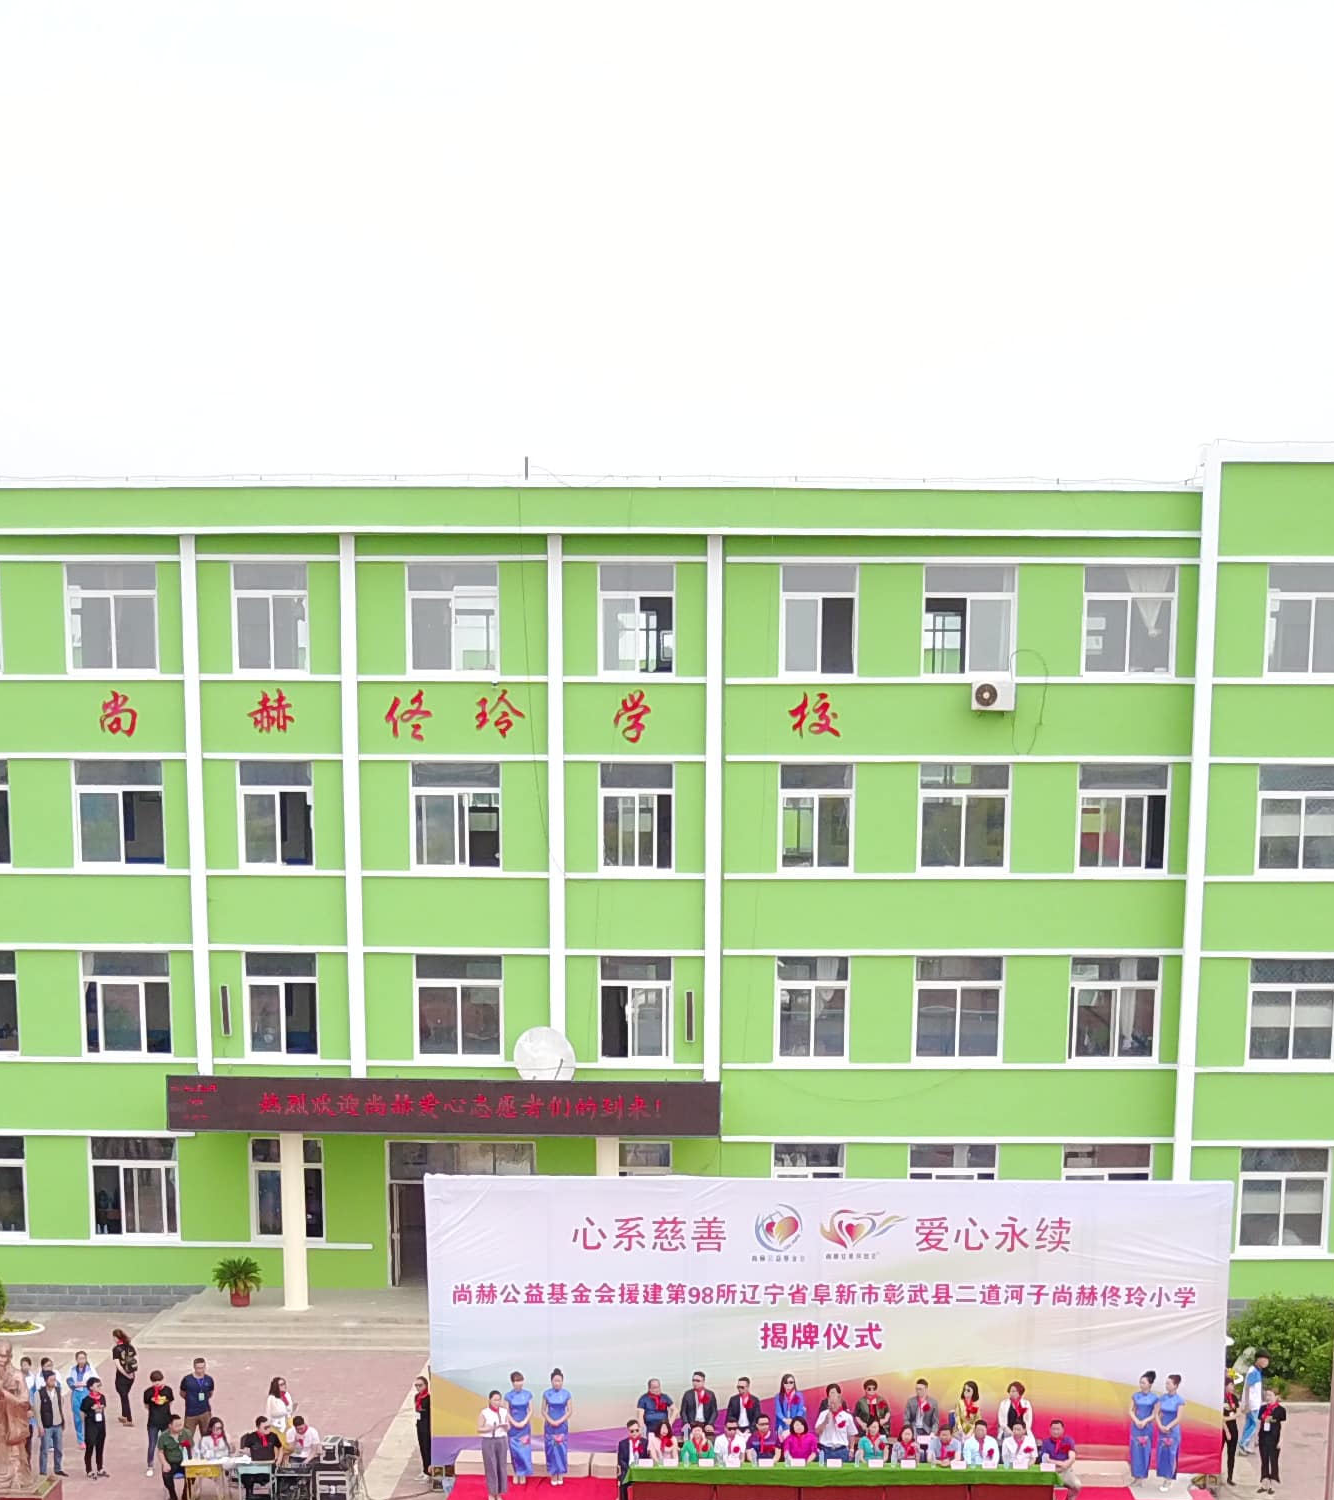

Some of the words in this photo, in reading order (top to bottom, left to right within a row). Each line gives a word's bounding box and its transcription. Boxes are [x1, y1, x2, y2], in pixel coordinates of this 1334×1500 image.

[99, 689, 842, 744] 尚赫佟玲学校
[571, 1216, 727, 1253] 心系慈善
[914, 1216, 1073, 1254] 爱心永续
[452, 1282, 1197, 1308] 尚赫公益基金会援建第98所辽宁省阜新市彰武县二道河子尚赫佟玲小学
[760, 1321, 883, 1352] 揭牌仪式
